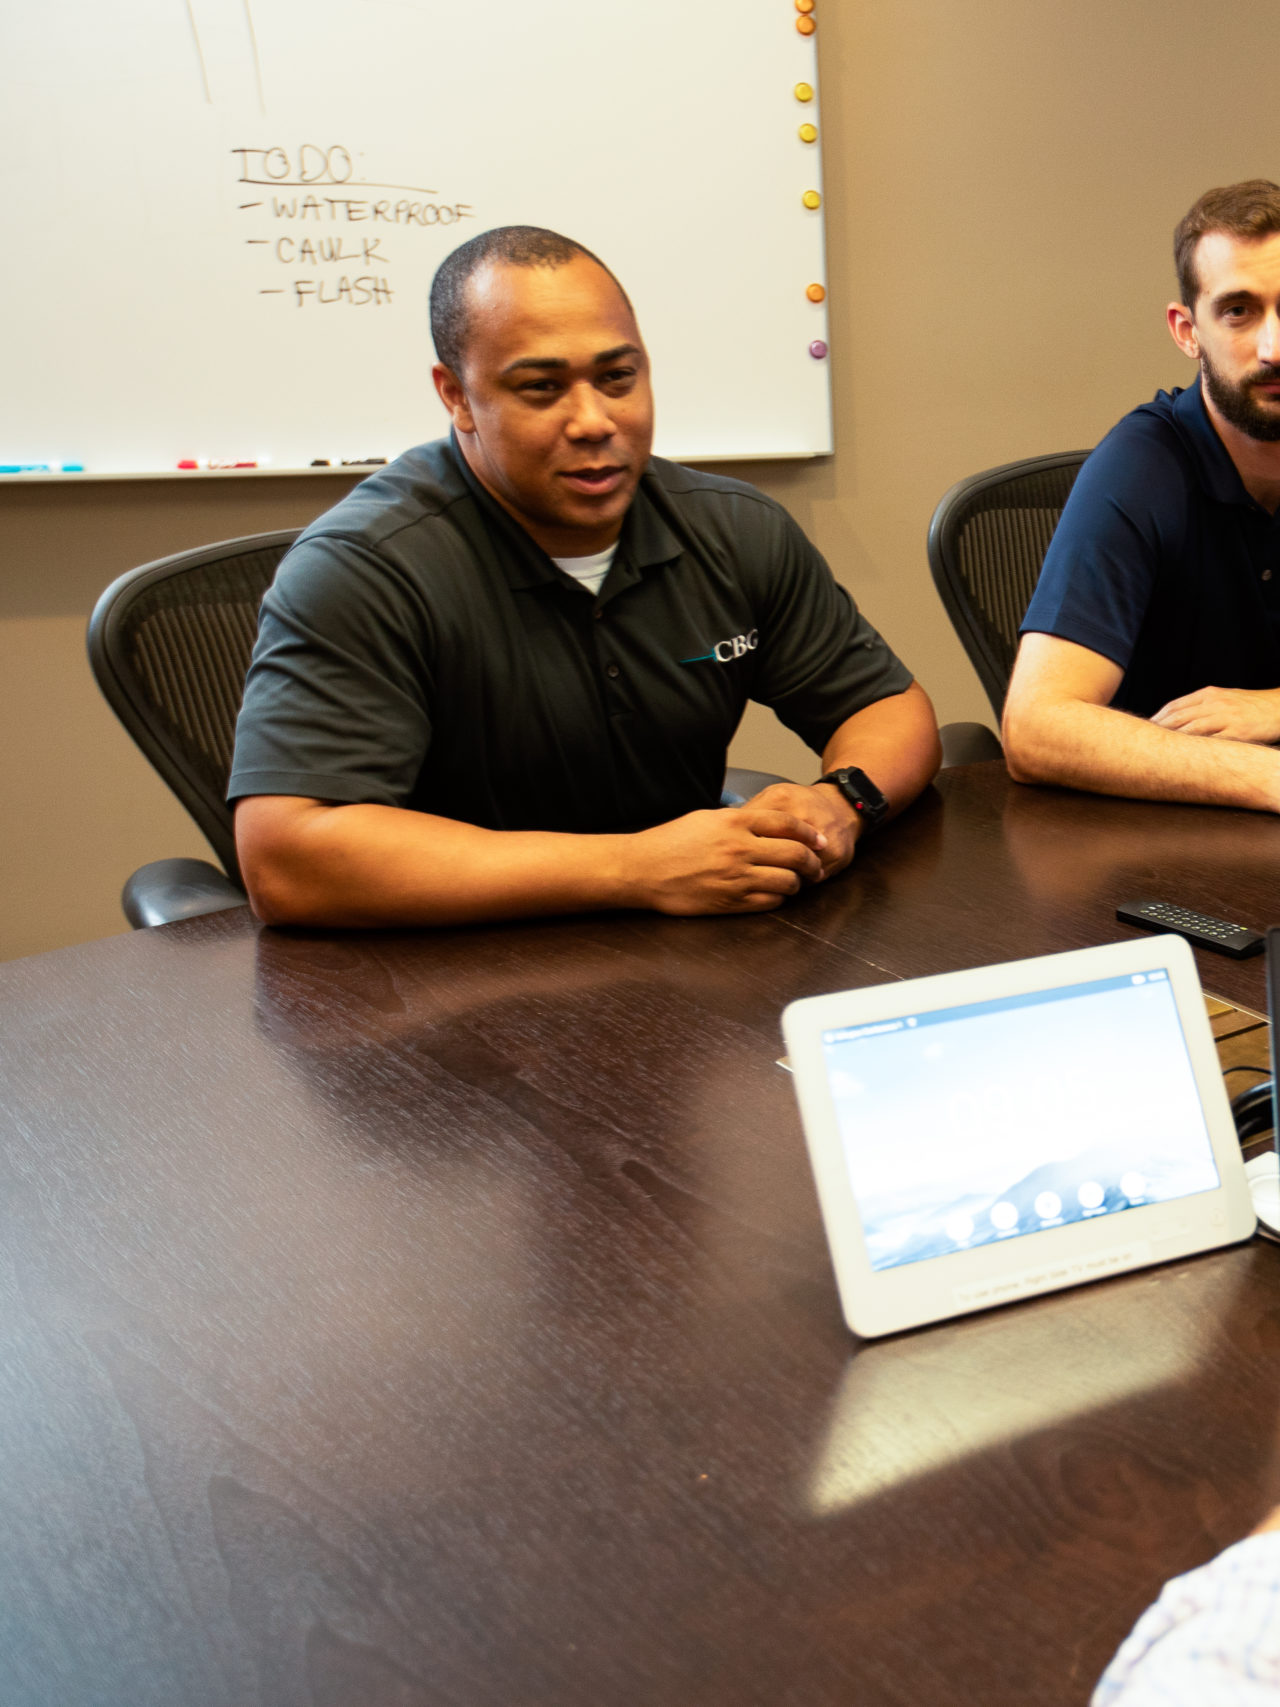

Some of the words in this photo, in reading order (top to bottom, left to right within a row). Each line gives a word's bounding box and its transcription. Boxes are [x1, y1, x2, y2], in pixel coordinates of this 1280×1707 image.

[272, 194, 476, 227] WATERPROOF
[276, 236, 391, 266] CAULK
[294, 275, 395, 308] FLASH
[713, 628, 759, 662] CBG
